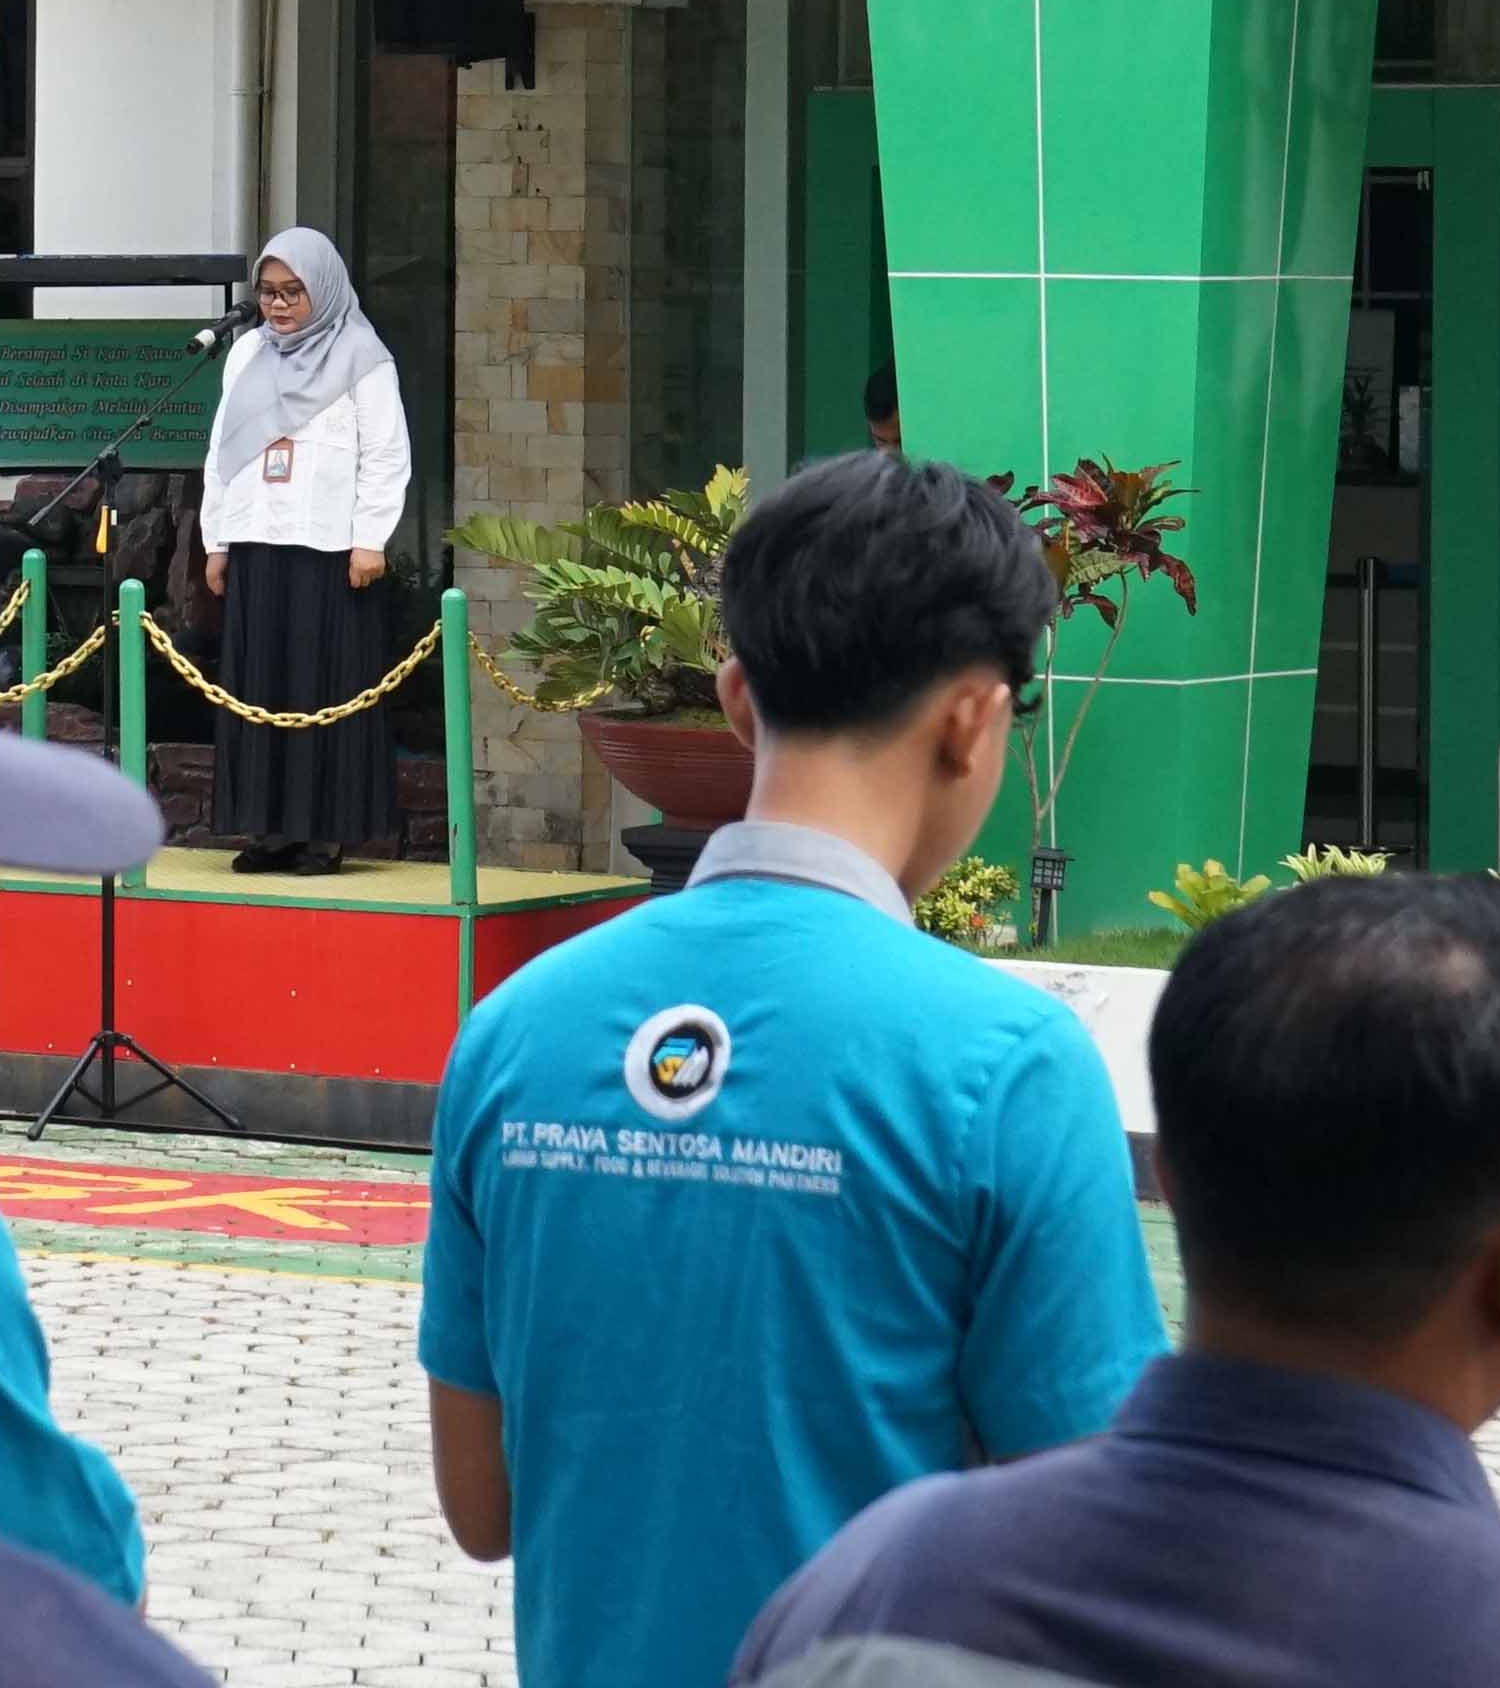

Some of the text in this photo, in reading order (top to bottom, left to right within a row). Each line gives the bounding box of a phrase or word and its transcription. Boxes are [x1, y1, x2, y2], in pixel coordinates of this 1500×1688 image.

[502, 1121, 843, 1175] PT. PRAYA SENTOSA MANDIRI
